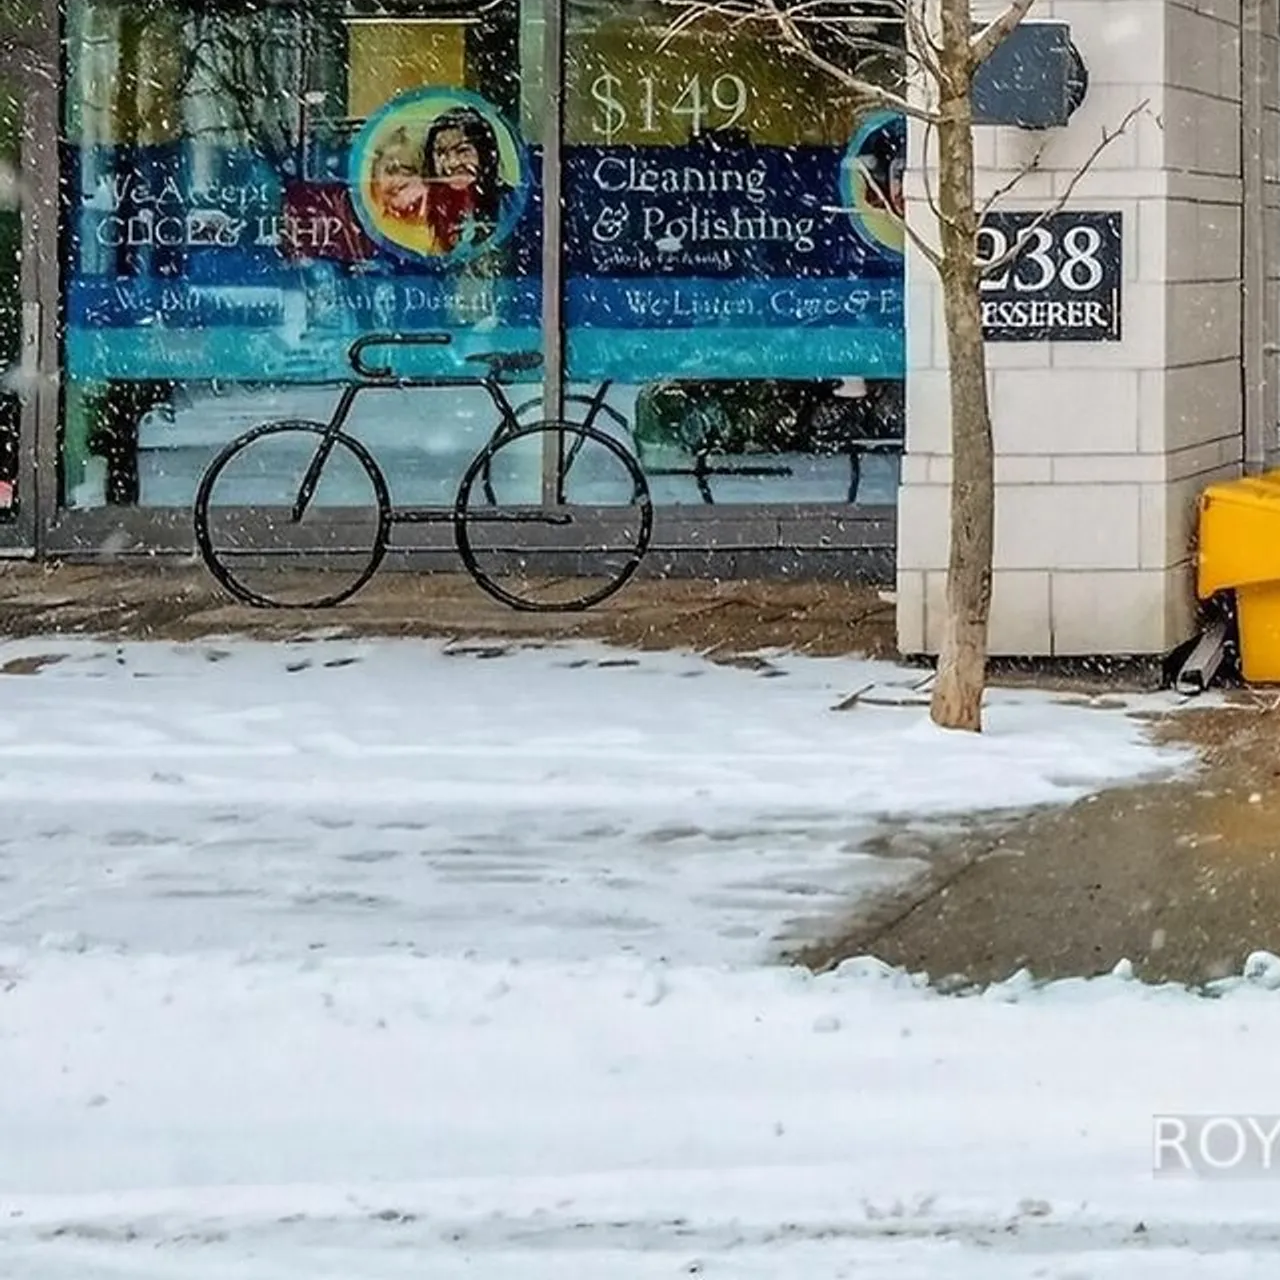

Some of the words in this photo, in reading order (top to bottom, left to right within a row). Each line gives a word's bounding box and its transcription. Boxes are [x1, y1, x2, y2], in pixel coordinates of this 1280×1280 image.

[591, 74, 748, 143] $149
[592, 157, 767, 201] Cleaning
[592, 204, 629, 242] &
[643, 206, 815, 251] Polishing
[973, 226, 1104, 291] 238
[980, 301, 1109, 328] ESSERER
